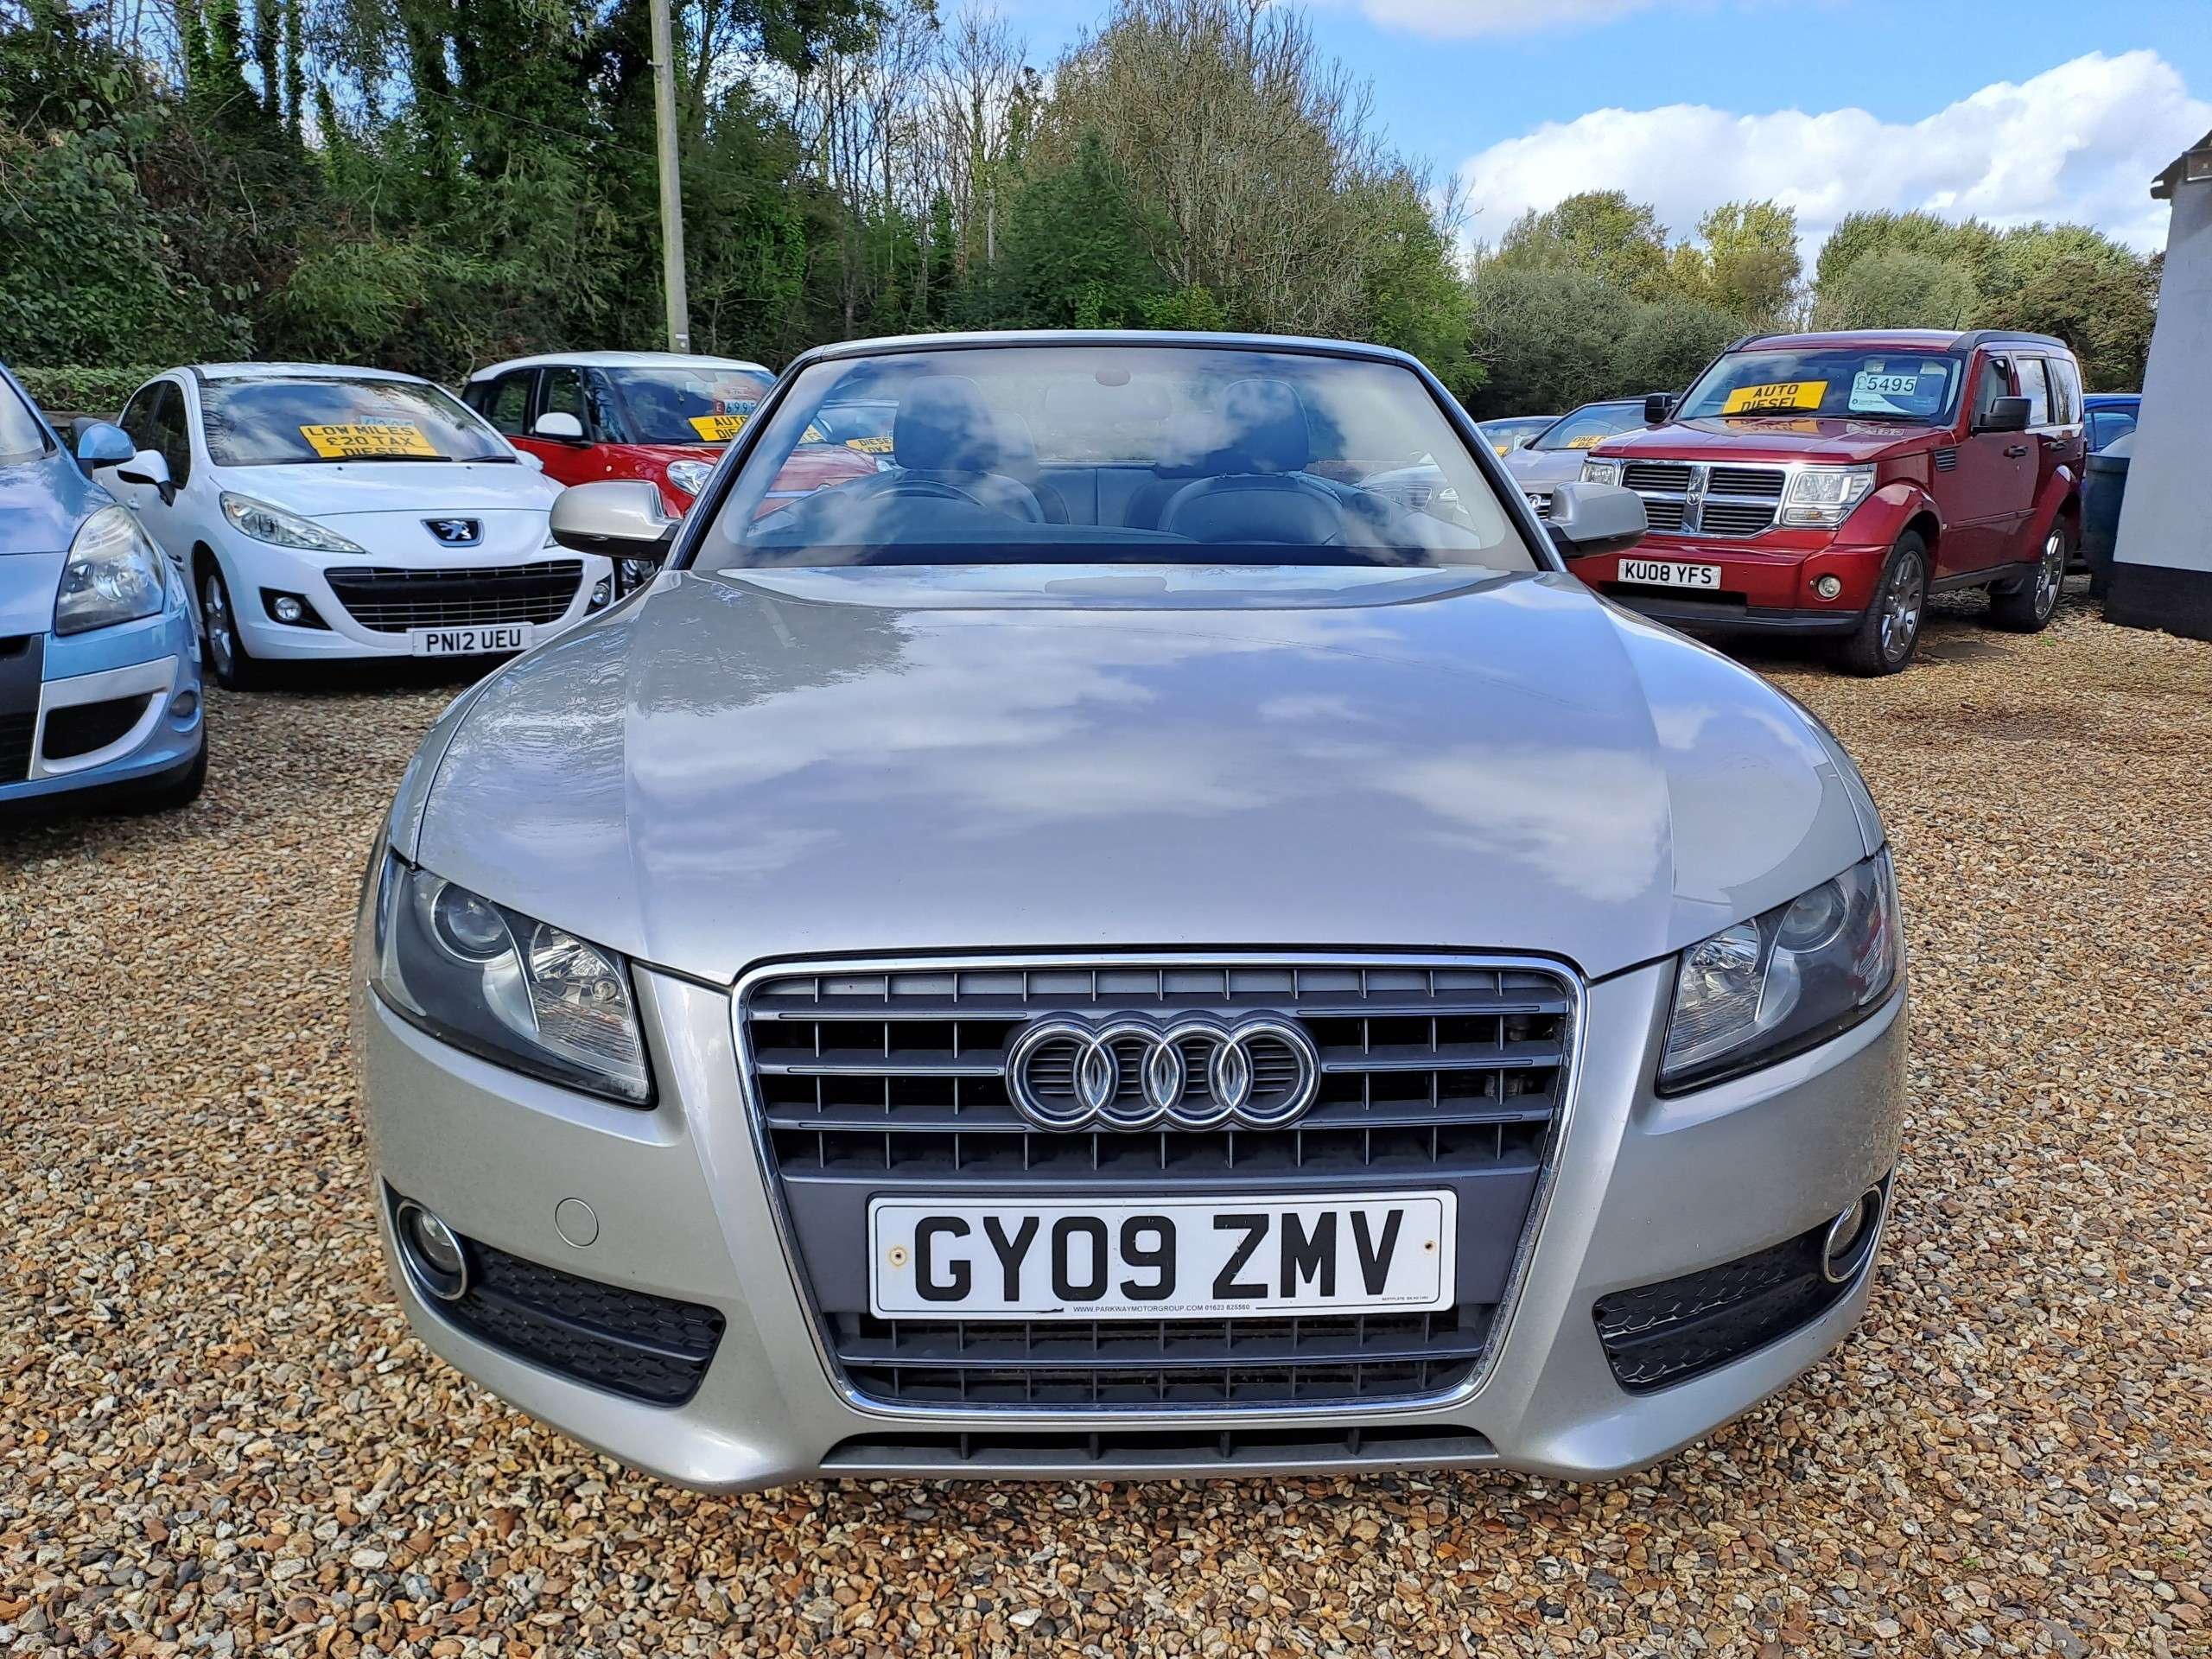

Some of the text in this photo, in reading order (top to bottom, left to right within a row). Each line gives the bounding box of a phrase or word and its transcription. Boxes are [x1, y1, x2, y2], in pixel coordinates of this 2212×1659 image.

[1752, 385, 1799, 398] AUTO
[1741, 397, 1796, 410] DIESEL
[306, 426, 415, 436] LOW MILES
[326, 436, 416, 447] £20 TAX
[1625, 562, 1712, 584] KU08 YFS
[426, 629, 521, 652] PN12 UEU
[914, 1209, 1404, 1303] GY09 ZMV
[1072, 1304, 1204, 1313] WWW.PARKWAYMOTORGROUP.COM
